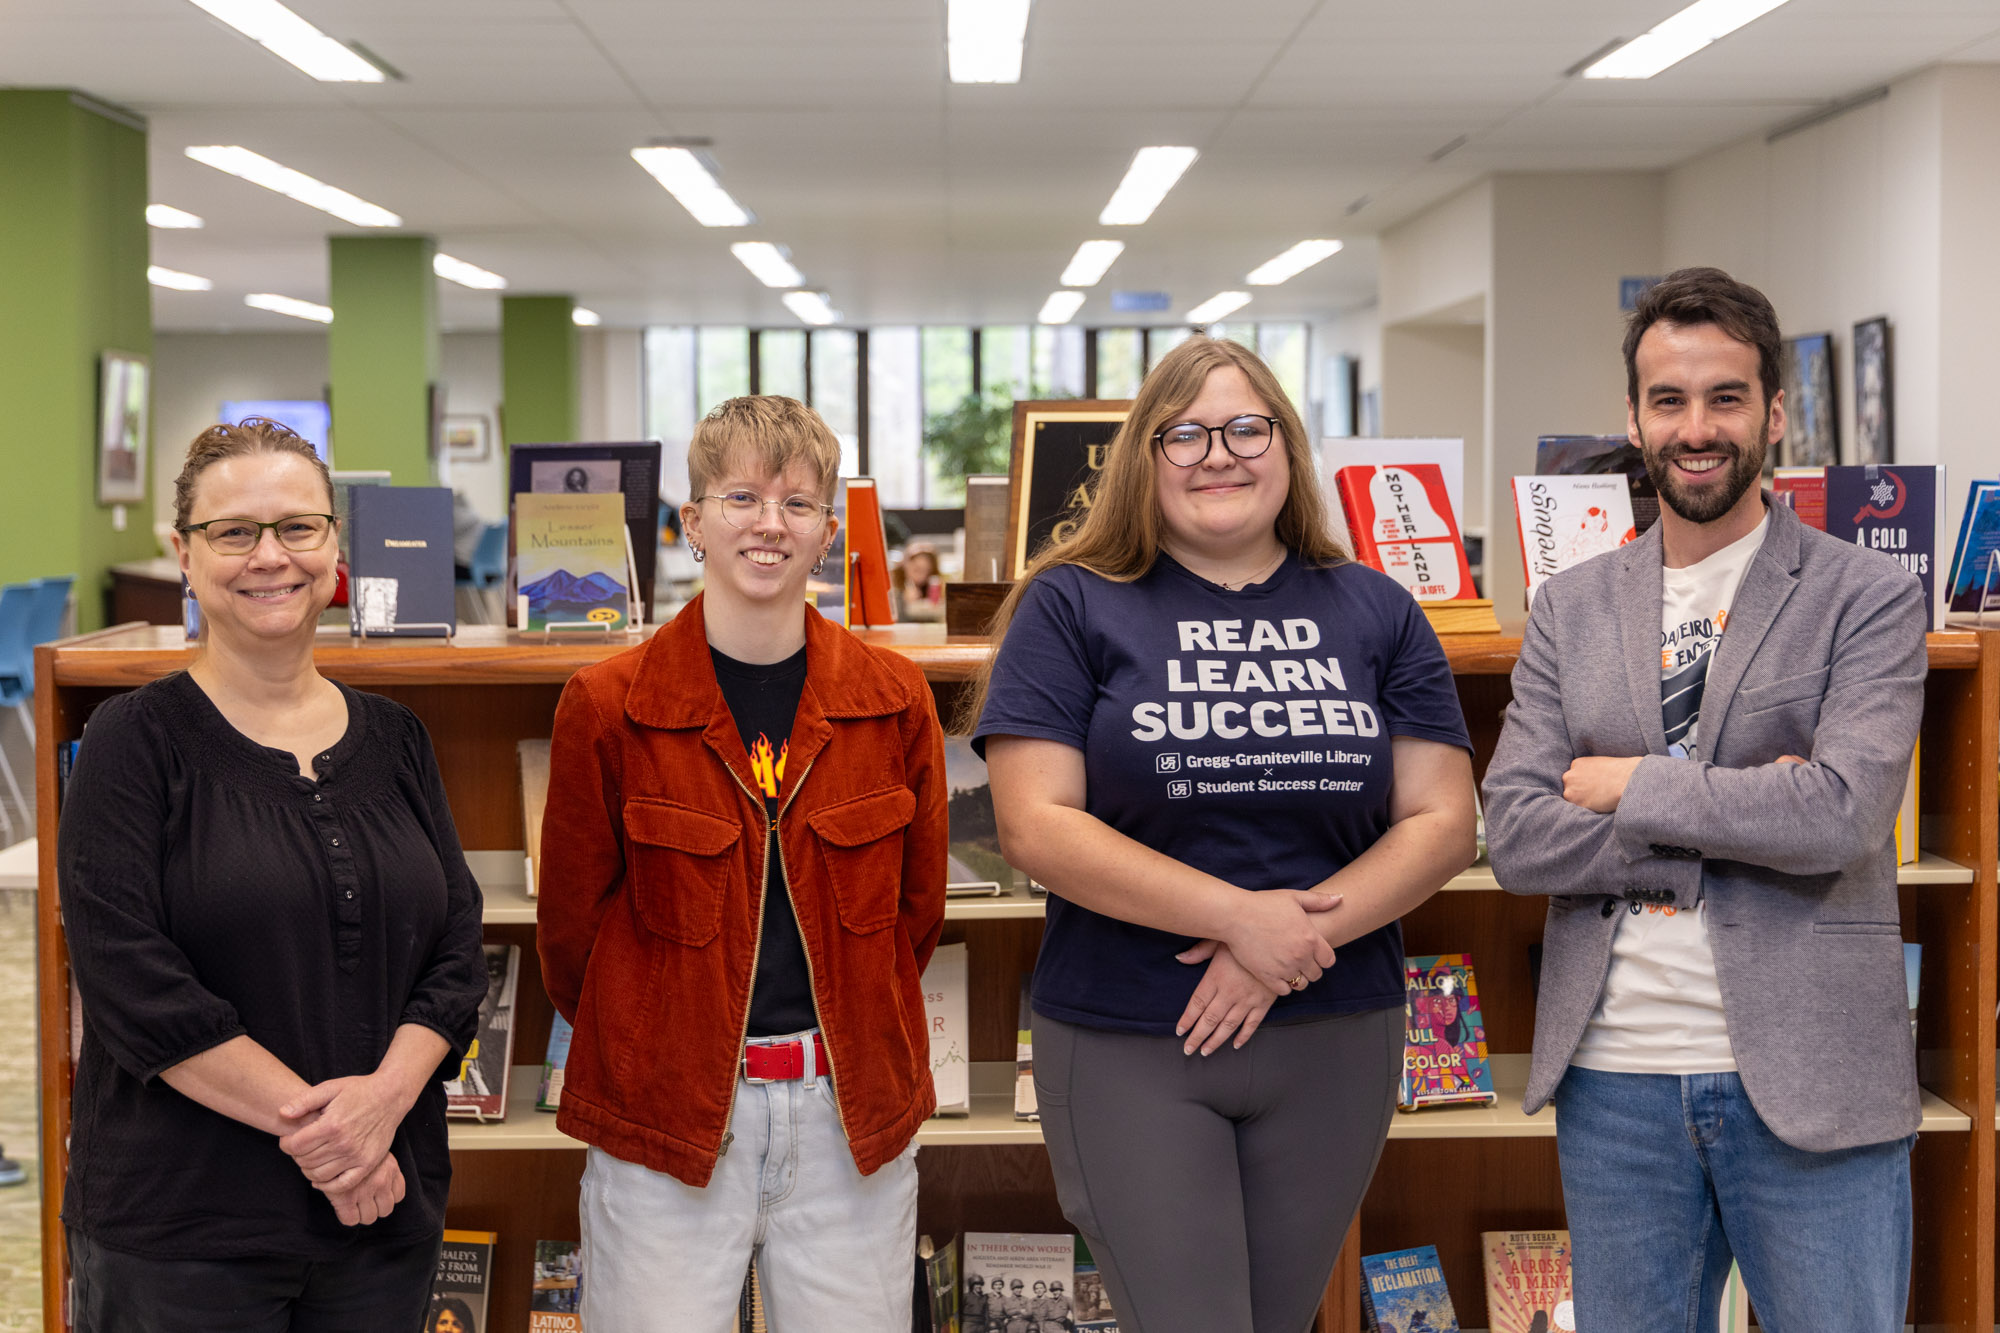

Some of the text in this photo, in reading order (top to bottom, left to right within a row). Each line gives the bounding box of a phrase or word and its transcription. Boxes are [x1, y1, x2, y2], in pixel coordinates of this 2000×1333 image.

[1385, 474, 1431, 583] MOTHERLAND
[1529, 481, 1558, 577] firebugs
[531, 533, 614, 549] Mountains
[1856, 527, 1908, 549] A COLD
[1177, 618, 1321, 652] READ
[1167, 657, 1347, 692] LEARN
[1131, 699, 1380, 742] SUCCEED
[1186, 751, 1323, 769] Gregg-Graniteville
[1326, 750, 1372, 766] Library
[1197, 780, 1255, 794] Student
[1257, 778, 1316, 791] Success
[1319, 778, 1364, 792] Center
[1405, 974, 1469, 991] ALLORY
[1405, 1028, 1438, 1043] ULL
[1405, 1053, 1462, 1070] COLOR
[1532, 1233, 1557, 1242] BEHAR
[966, 1244, 1072, 1254] IN THEIR OWN WORDS
[448, 1261, 479, 1272] FROM
[1384, 1258, 1399, 1270] THE
[1510, 1258, 1562, 1274] ACROSS
[445, 1272, 482, 1284] SOUTH
[1371, 1266, 1441, 1294] RECLAMATION
[1505, 1275, 1569, 1290] SO MANY
[1523, 1290, 1554, 1305] SEAS
[533, 1315, 576, 1330] LATINO
